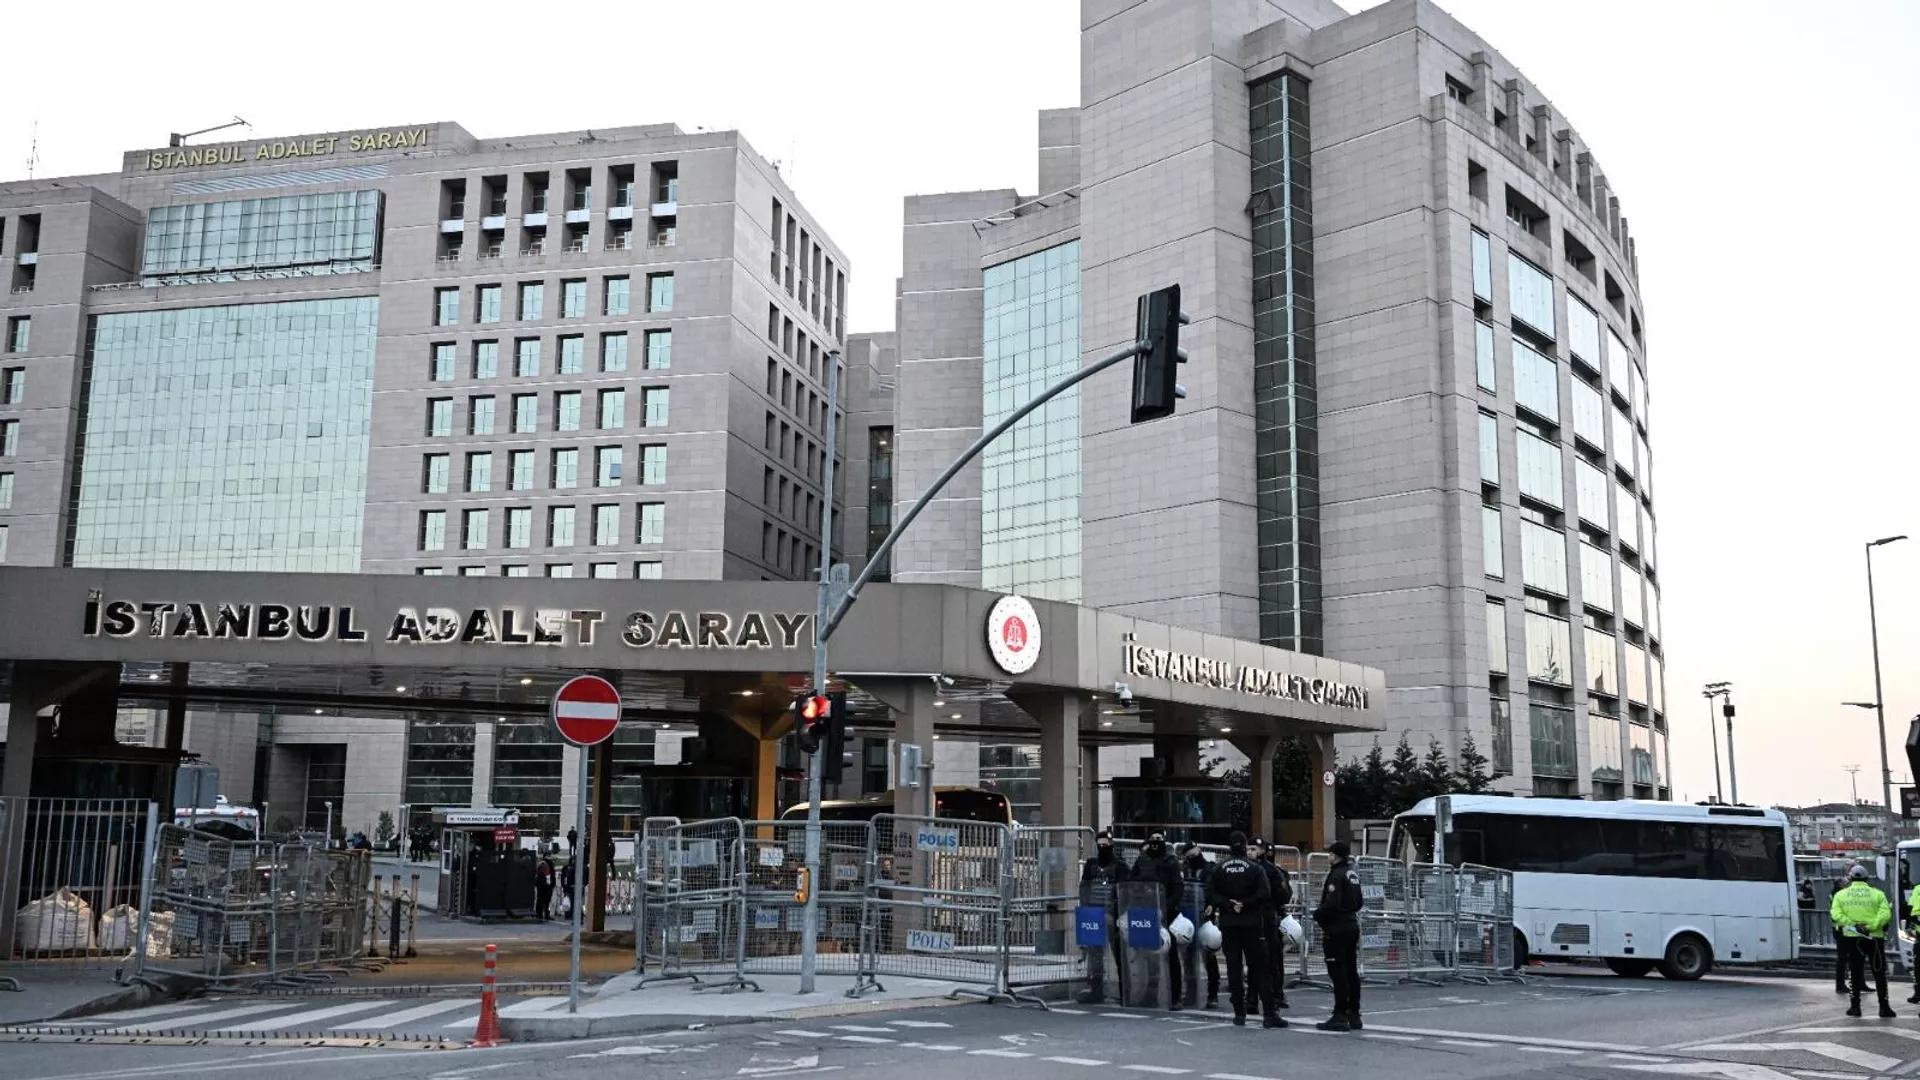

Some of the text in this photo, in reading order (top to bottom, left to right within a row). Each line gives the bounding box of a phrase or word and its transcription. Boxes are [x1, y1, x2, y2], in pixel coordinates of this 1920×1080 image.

[146, 128, 428, 171] İSTANBUL ADALET SARAYI
[83, 587, 369, 643] İSTANBUL
[385, 607, 607, 646] ADALET
